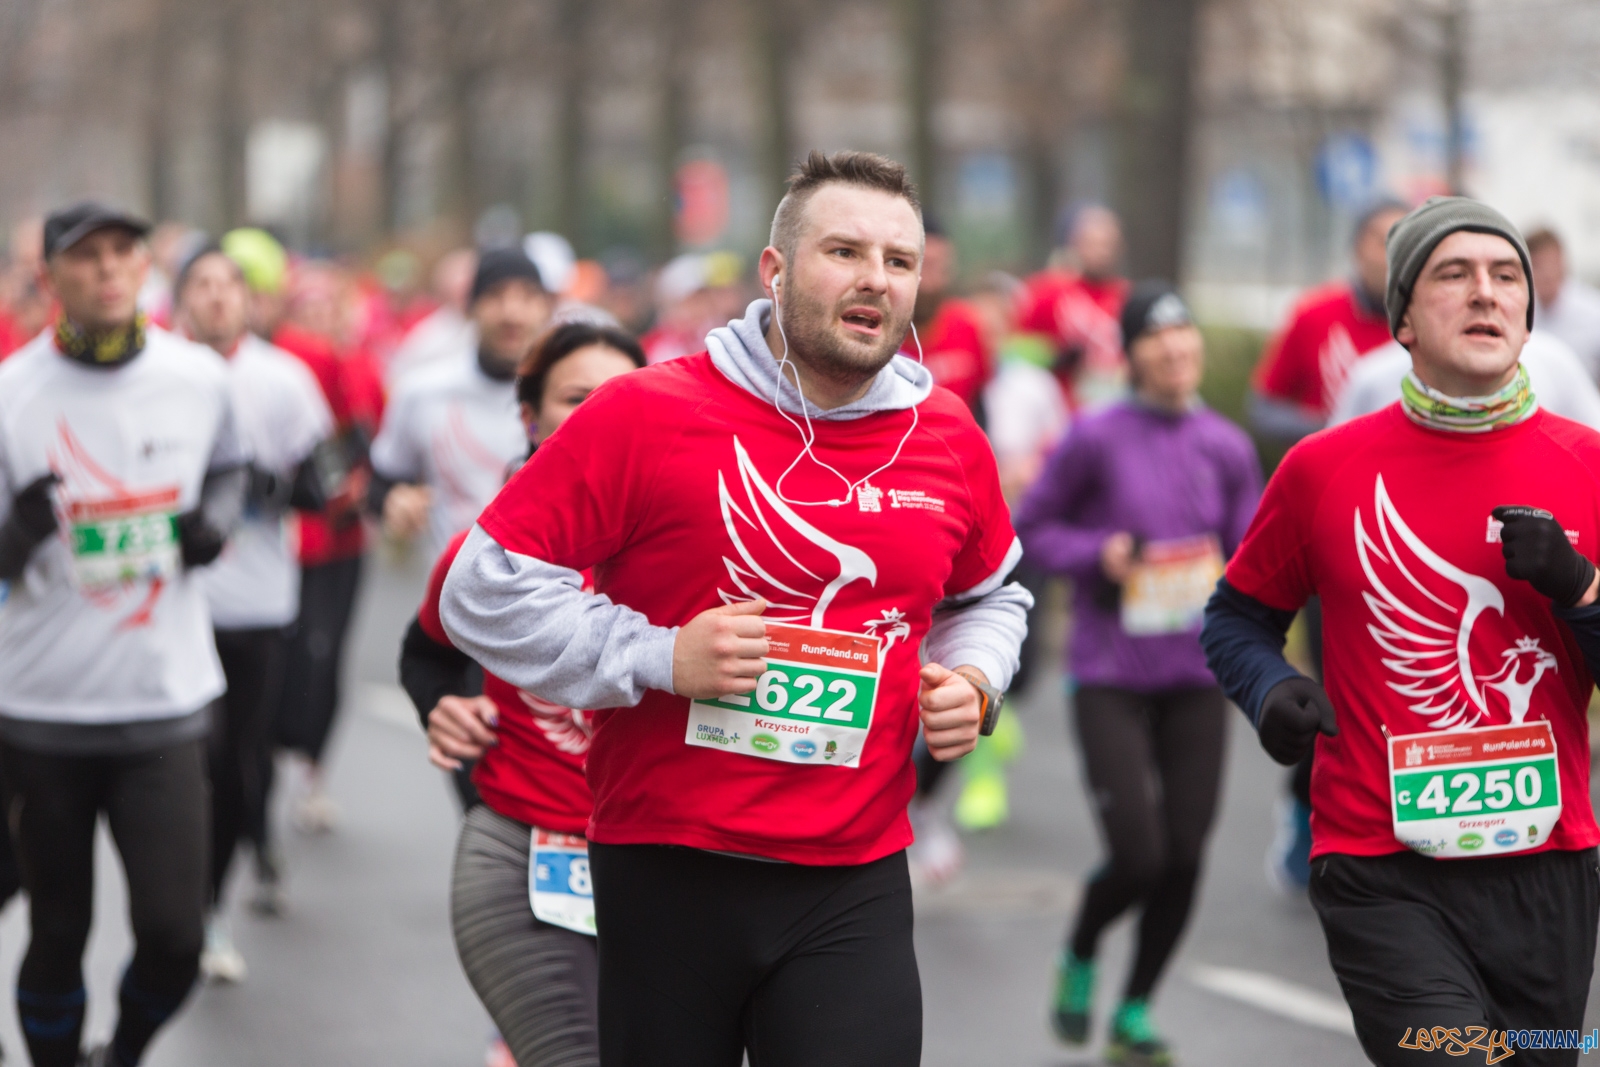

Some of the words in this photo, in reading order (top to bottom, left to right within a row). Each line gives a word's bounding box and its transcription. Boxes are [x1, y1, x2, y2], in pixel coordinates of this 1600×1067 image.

[888, 489, 901, 508] 1
[801, 643, 869, 663] RunPoland.org
[718, 670, 857, 722] 622
[697, 724, 725, 736] GRUPA
[755, 718, 810, 735] Krzysztof
[696, 732, 729, 745] LUXMED
[1482, 738, 1545, 753] RunPoland.org
[1416, 766, 1542, 815] 4250
[1459, 818, 1506, 829] Grzegorz
